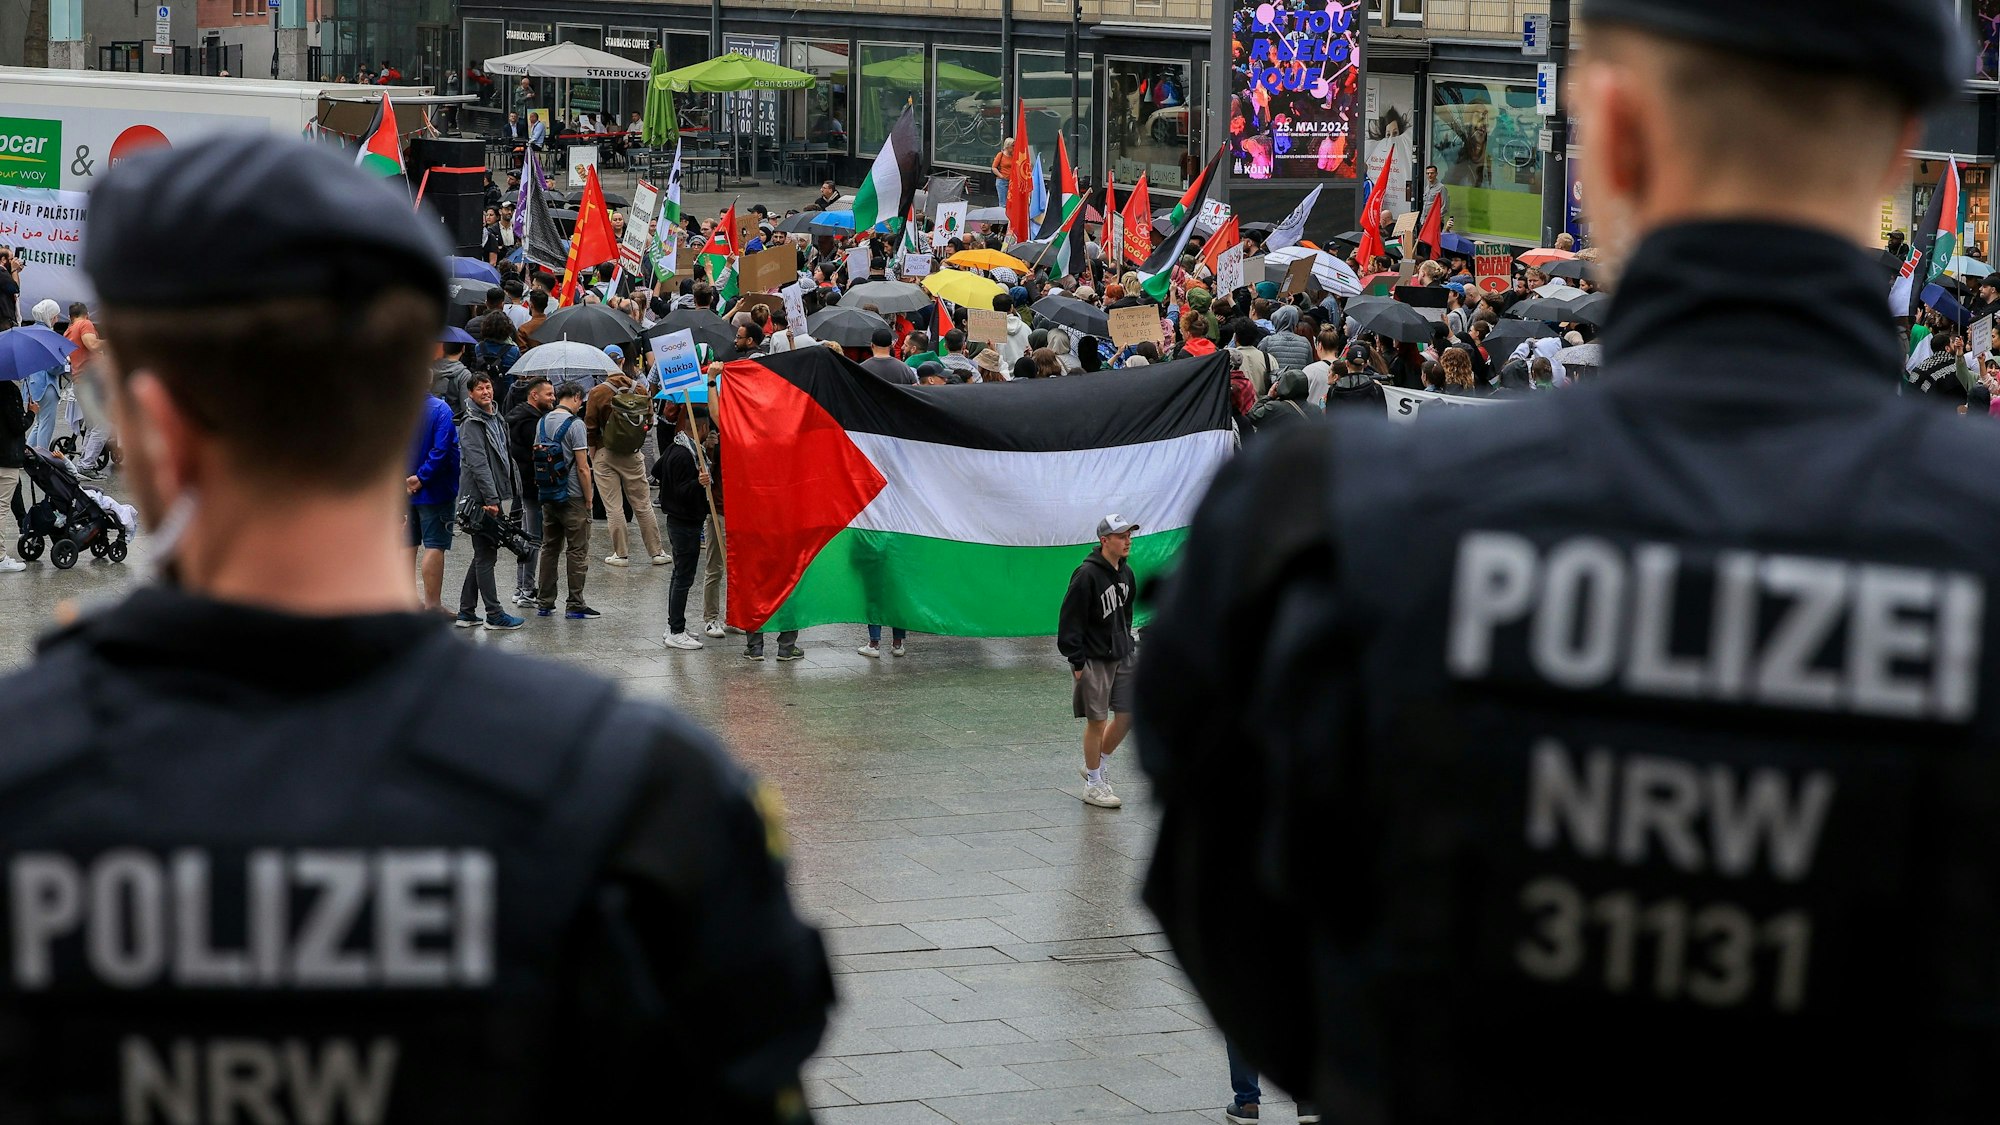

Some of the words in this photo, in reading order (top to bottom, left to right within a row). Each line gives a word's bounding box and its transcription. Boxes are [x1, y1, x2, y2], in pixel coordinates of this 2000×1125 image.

[1293, 10, 1352, 34] TOU
[506, 30, 529, 41] STARBUCKS
[530, 32, 546, 42] COFFEE
[605, 37, 631, 48] STARBUCKS
[632, 38, 650, 50] COFFEE
[730, 47, 752, 58] FESH
[755, 48, 776, 62] MADE
[1251, 38, 1271, 62] R
[1276, 38, 1349, 62] BELG
[587, 68, 647, 79] STARBUCKS
[1250, 67, 1322, 95] IQUE
[754, 79, 774, 87] dean
[783, 79, 806, 87] david
[1276, 121, 1293, 132] 25.
[1295, 121, 1318, 132] MAI
[1320, 121, 1349, 132] 2024
[71, 145, 95, 177] &
[20, 169, 46, 183] way
[1151, 169, 1176, 184] LOUNGE
[1244, 163, 1270, 175] KÖLN
[1965, 170, 1985, 184] GIFT
[12, 200, 31, 216] FÜR
[20, 249, 76, 267] ALESTINE!
[1476, 256, 1510, 276] RAFAH
[1116, 312, 1124, 321] No
[1137, 329, 1152, 337] FREE
[660, 341, 687, 353] Google
[664, 362, 694, 375] Nakba
[1446, 530, 1984, 723] POLIZEI
[1526, 737, 1835, 882] NRW
[8, 848, 496, 991] POLIZEI
[1516, 877, 1813, 1012] 31131
[118, 1034, 400, 1125] NRW
